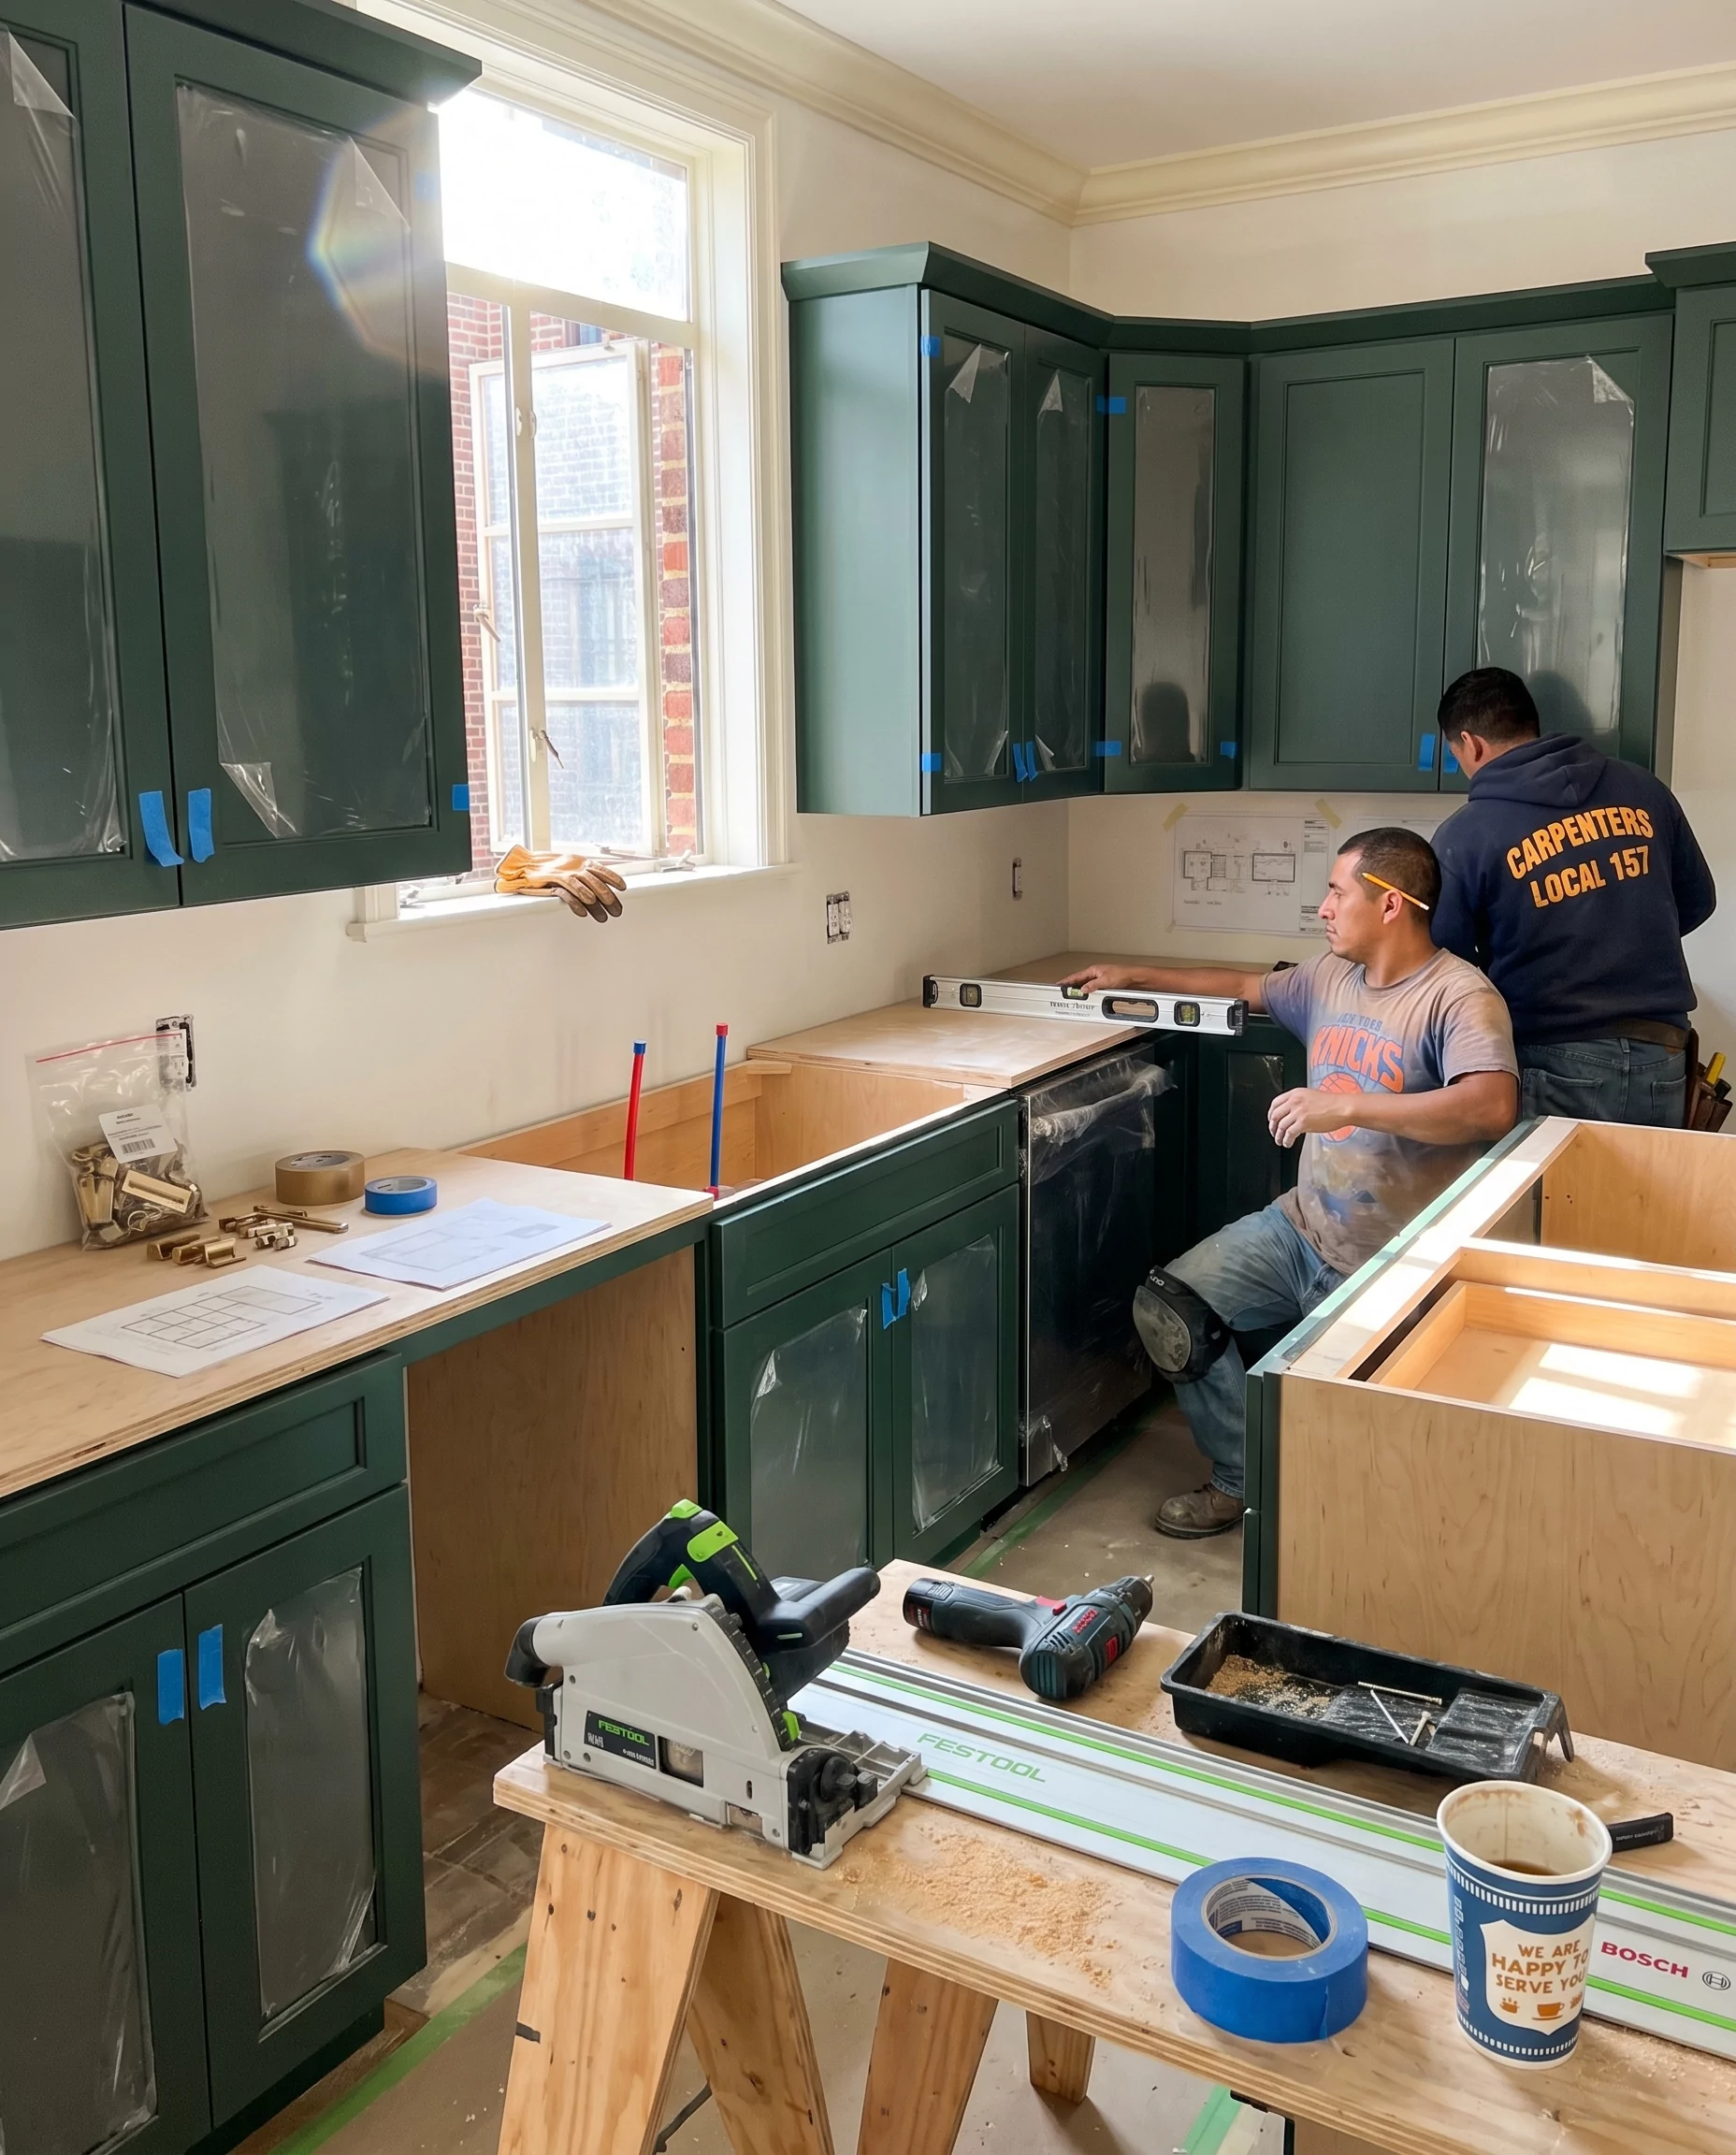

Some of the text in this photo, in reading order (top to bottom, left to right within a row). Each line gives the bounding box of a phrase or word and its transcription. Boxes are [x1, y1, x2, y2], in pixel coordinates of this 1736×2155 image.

[1506, 806, 1655, 880] CARPENTERS
[1529, 845, 1650, 908] LOCAL 157
[1310, 1024, 1405, 1094] KNICKS
[917, 1732, 1047, 1784] FESTOOL
[1492, 1947, 1589, 1976] HAPPY TO
[1517, 1939, 1581, 1959] WE ARE
[1600, 1941, 1689, 1978] BOSCH
[1496, 1966, 1586, 1994] SERVE YOU
